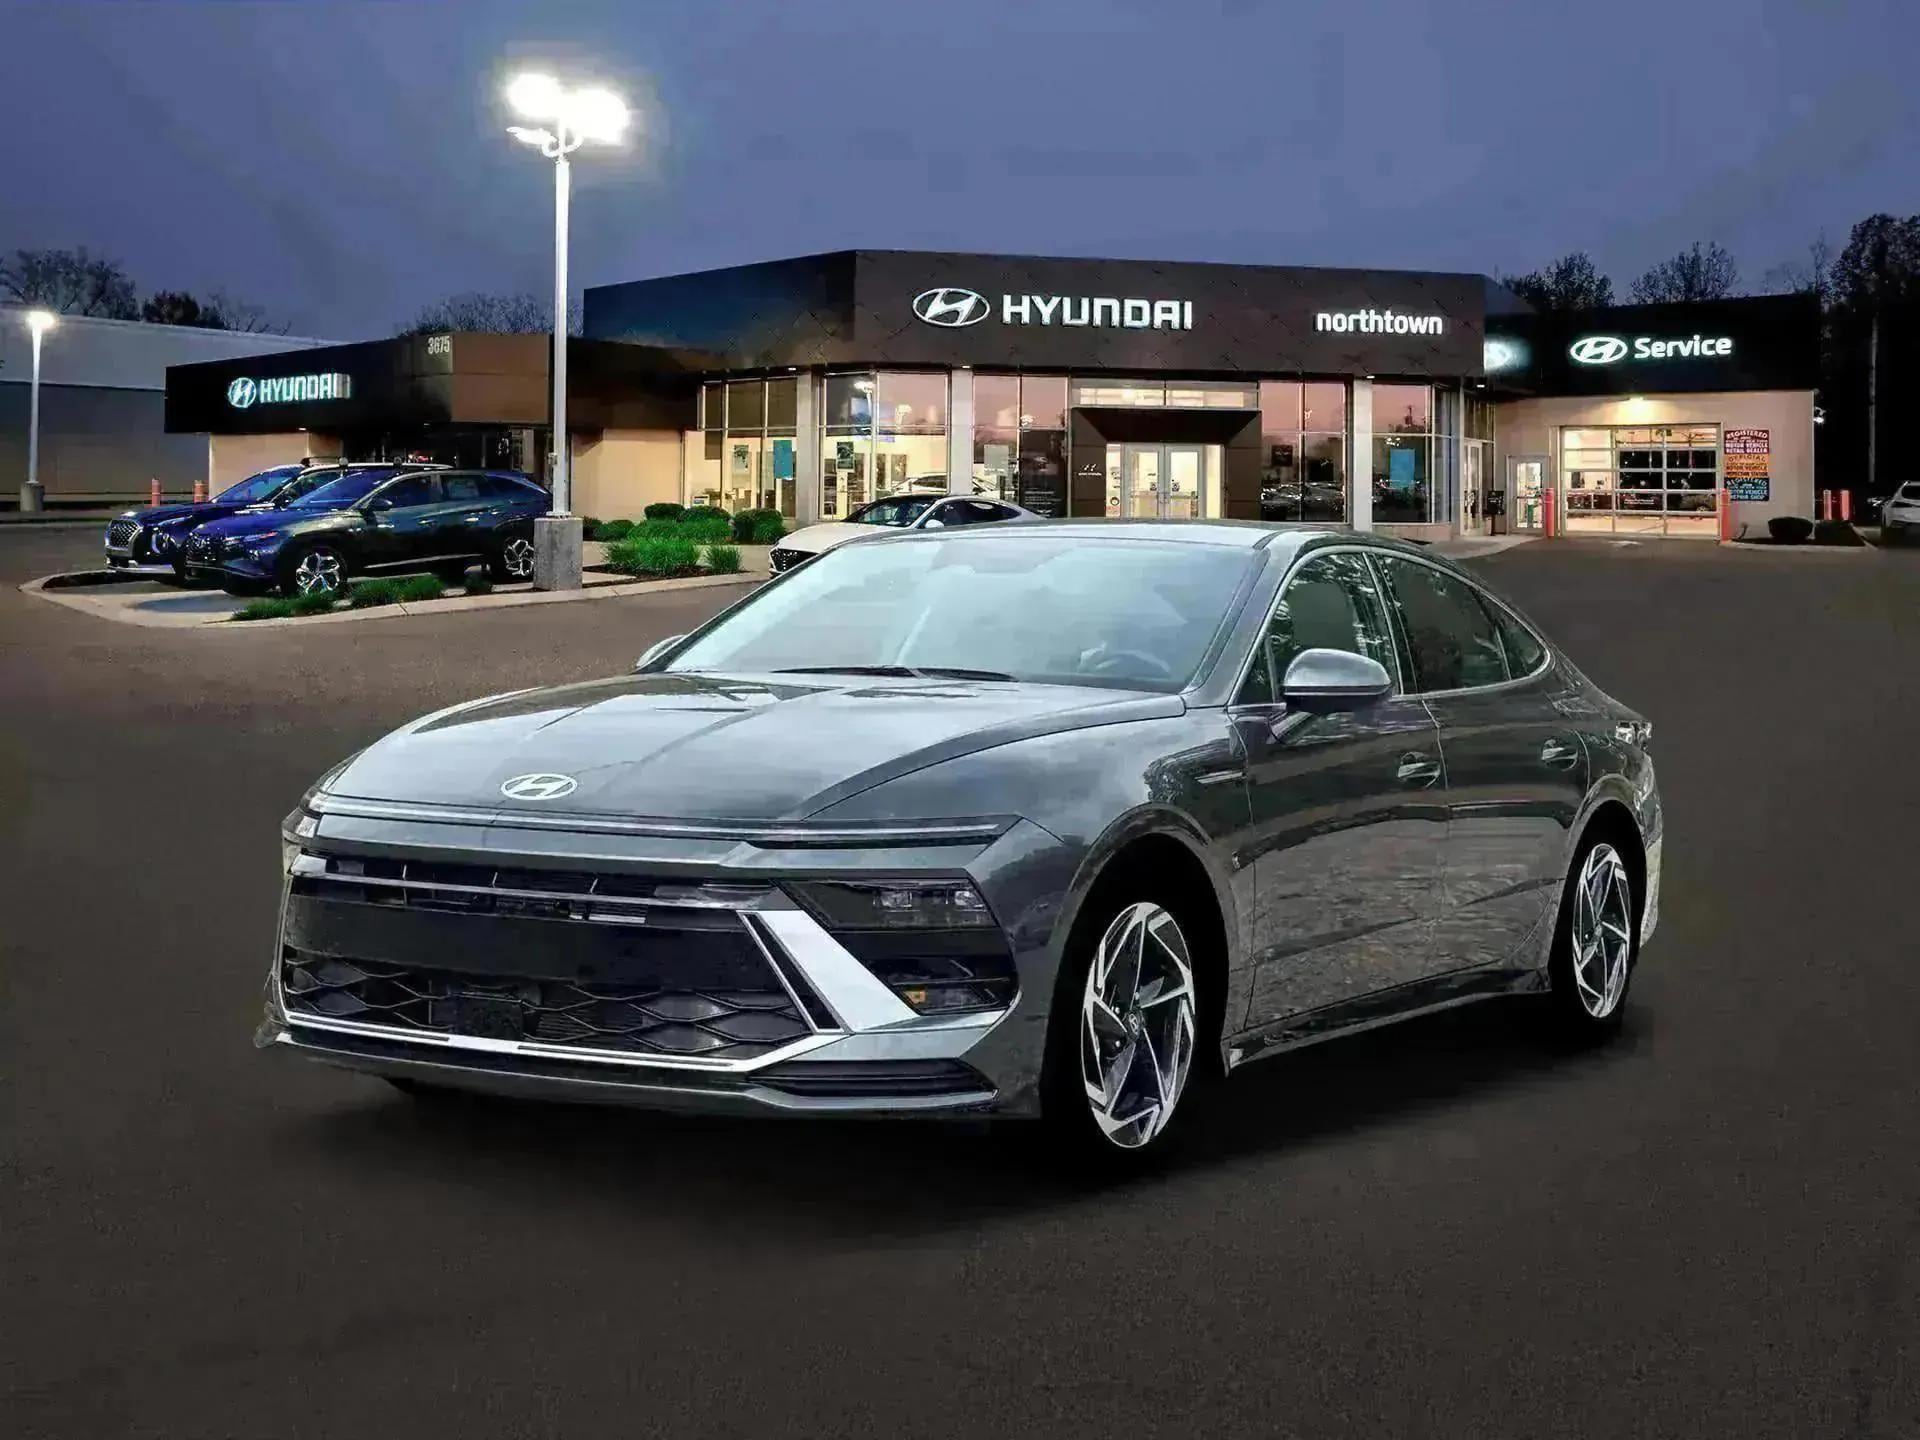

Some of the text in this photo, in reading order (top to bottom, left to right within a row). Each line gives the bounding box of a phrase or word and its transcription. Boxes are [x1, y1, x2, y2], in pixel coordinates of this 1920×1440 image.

[1002, 294, 1192, 330] HYUNDAI
[1317, 309, 1443, 334] northtown
[1634, 335, 1732, 359] Service
[260, 372, 344, 403] HYUNDAI
[1726, 430, 1768, 439] REGISTERED
